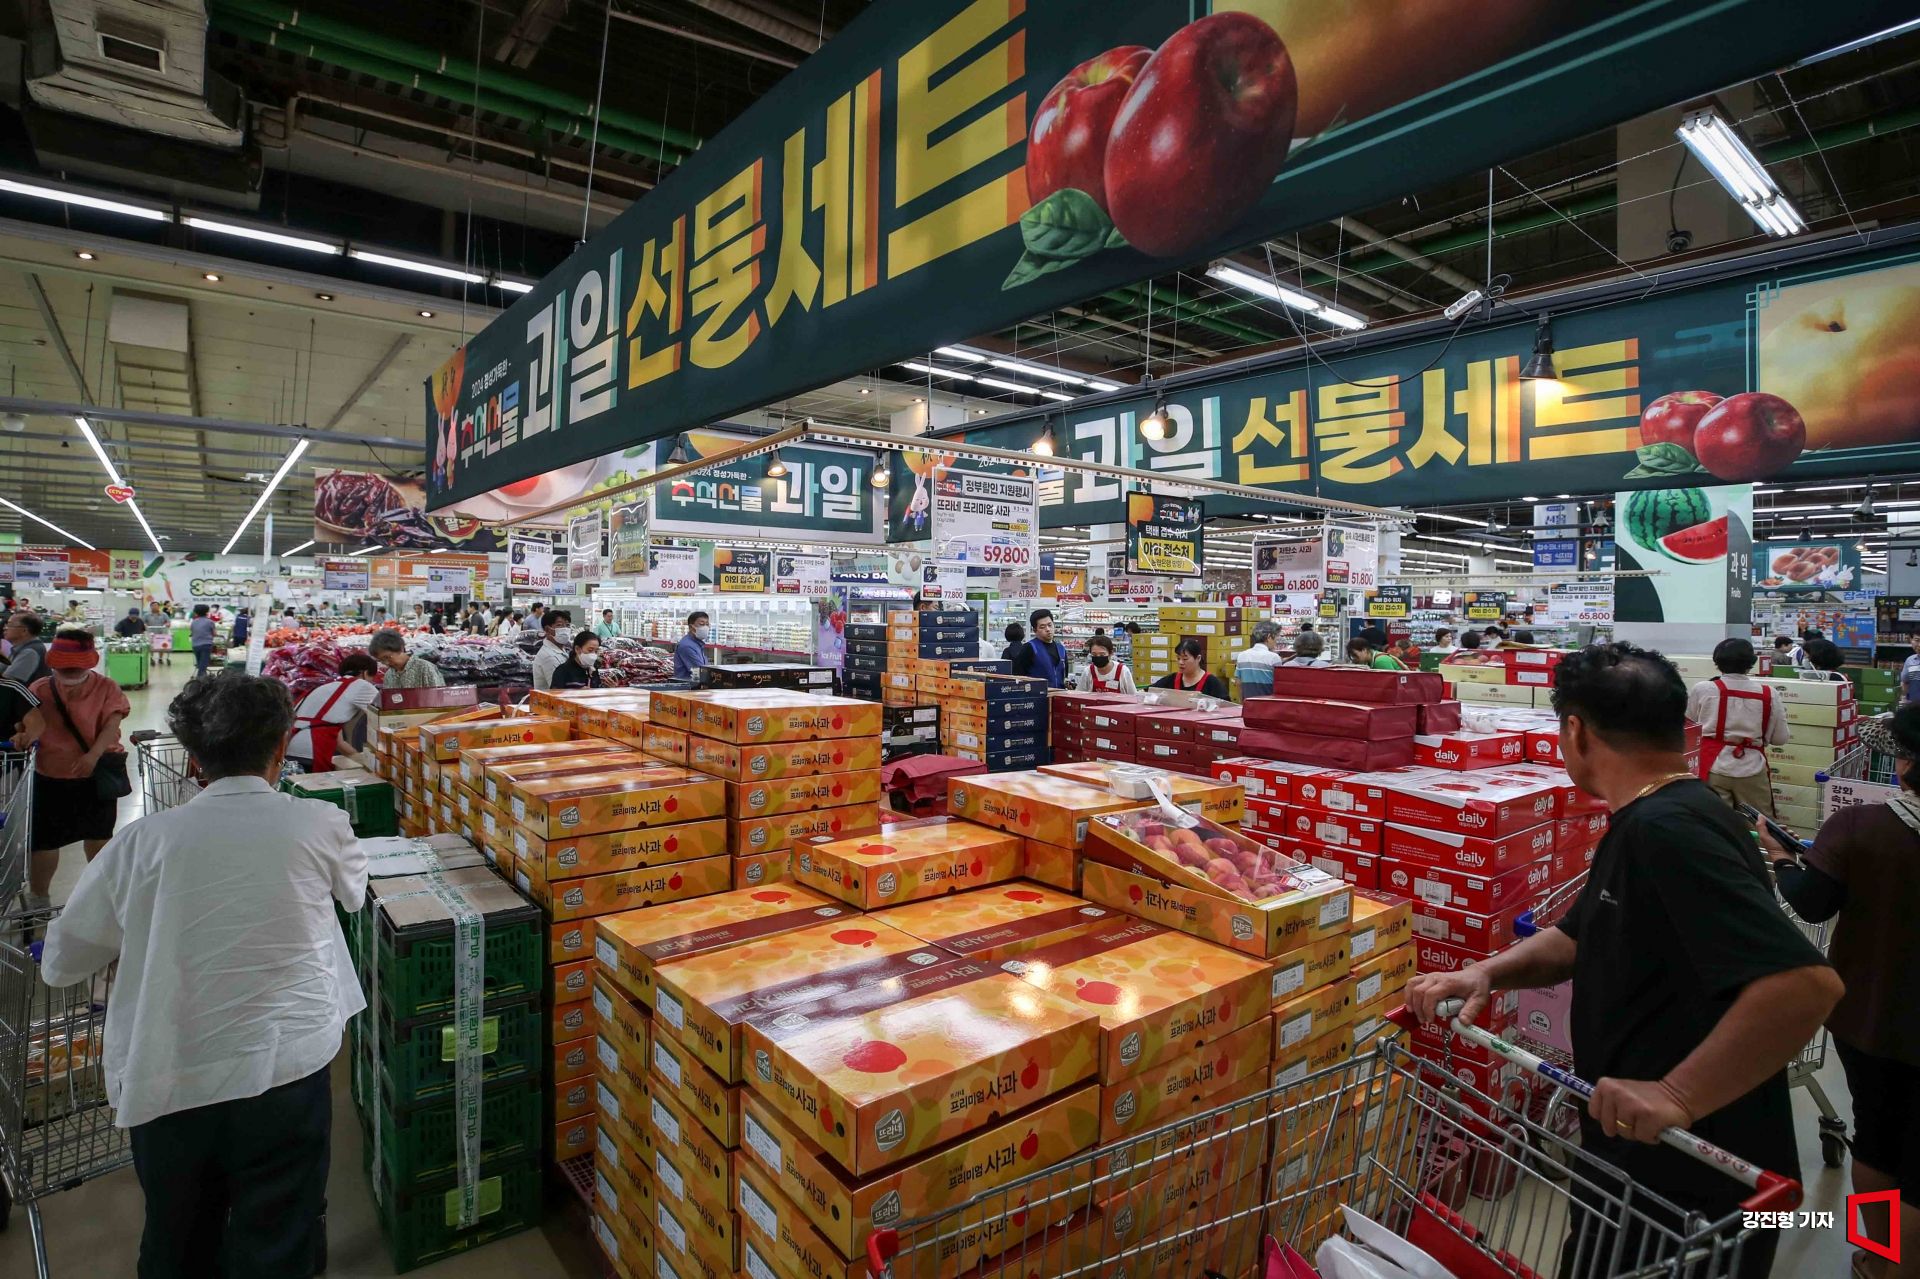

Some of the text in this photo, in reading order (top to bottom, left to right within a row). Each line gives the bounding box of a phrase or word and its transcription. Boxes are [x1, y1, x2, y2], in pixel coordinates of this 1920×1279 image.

[522, 0, 1026, 440] 과일 선물세트
[1074, 337, 1640, 502] 과일 선물세트
[713, 469, 748, 480] 정성가득한
[671, 461, 862, 520] 추석선물 과일
[966, 480, 1030, 499] 정부할인 지원행사
[937, 499, 1010, 517] 뜨라네 프리미엄 사과
[1145, 524, 1160, 537] 택배
[984, 545, 1030, 564] 59,800
[1143, 541, 1163, 557] 야외
[1299, 545, 1312, 553] 사과
[1731, 552, 1748, 581] 과일
[531, 577, 549, 587] 84,800
[661, 579, 696, 590] 89,800
[1217, 582, 1236, 590] Cafe
[1287, 580, 1319, 591] 61,800
[1351, 572, 1374, 586] 51,800
[803, 586, 828, 594] 75,800
[944, 591, 963, 599] 77,800
[1018, 589, 1038, 598] 61,800
[1057, 585, 1069, 593] ead
[1130, 584, 1154, 594] 65,800
[1579, 612, 1611, 620] 65,800
[811, 716, 831, 730] 사과
[502, 733, 521, 744] 사과
[1434, 749, 1460, 763] daily
[1501, 743, 1515, 757] daily
[812, 752, 831, 766] 사과
[812, 785, 830, 799] 사과
[1303, 787, 1316, 795] daily
[1832, 785, 1854, 796] 강화
[612, 799, 662, 817] 프리미엄 사과
[1218, 799, 1232, 812] 사과
[1534, 799, 1548, 813] daily
[1000, 806, 1019, 823] 사과
[1457, 811, 1488, 827] daily
[811, 820, 829, 834] 사과
[611, 839, 662, 857] 프리미엄 사과
[1532, 834, 1546, 849] daily
[1455, 850, 1486, 867] daily
[827, 867, 843, 884] 사과
[924, 864, 969, 883] 프리미엄 사과
[1392, 872, 1408, 882] daily
[1528, 870, 1542, 885] daily
[616, 877, 667, 897] 프리미엄 사과
[1145, 889, 1170, 911] 사과
[1389, 920, 1401, 934] 사과
[1322, 953, 1337, 968] 사과
[1421, 947, 1459, 971] daily
[1395, 962, 1407, 976] 사과
[1328, 999, 1343, 1016] 사과
[1169, 1007, 1217, 1039] 프리미엄 사과
[701, 1025, 715, 1050] 사과
[1166, 1064, 1215, 1095] 프리미엄 사과
[774, 1071, 818, 1120] 프리미엄 사과
[950, 1070, 1019, 1115] 프리미엄 사과
[697, 1088, 712, 1113] 사과
[879, 1124, 905, 1137] 뜨라네
[697, 1146, 712, 1173] 사과
[948, 1143, 1017, 1191] 프리미엄 사과
[806, 1178, 828, 1213] 사과
[701, 1205, 716, 1233] 사과
[874, 1205, 900, 1219] 뜨라네
[802, 1248, 823, 1279] 사과
